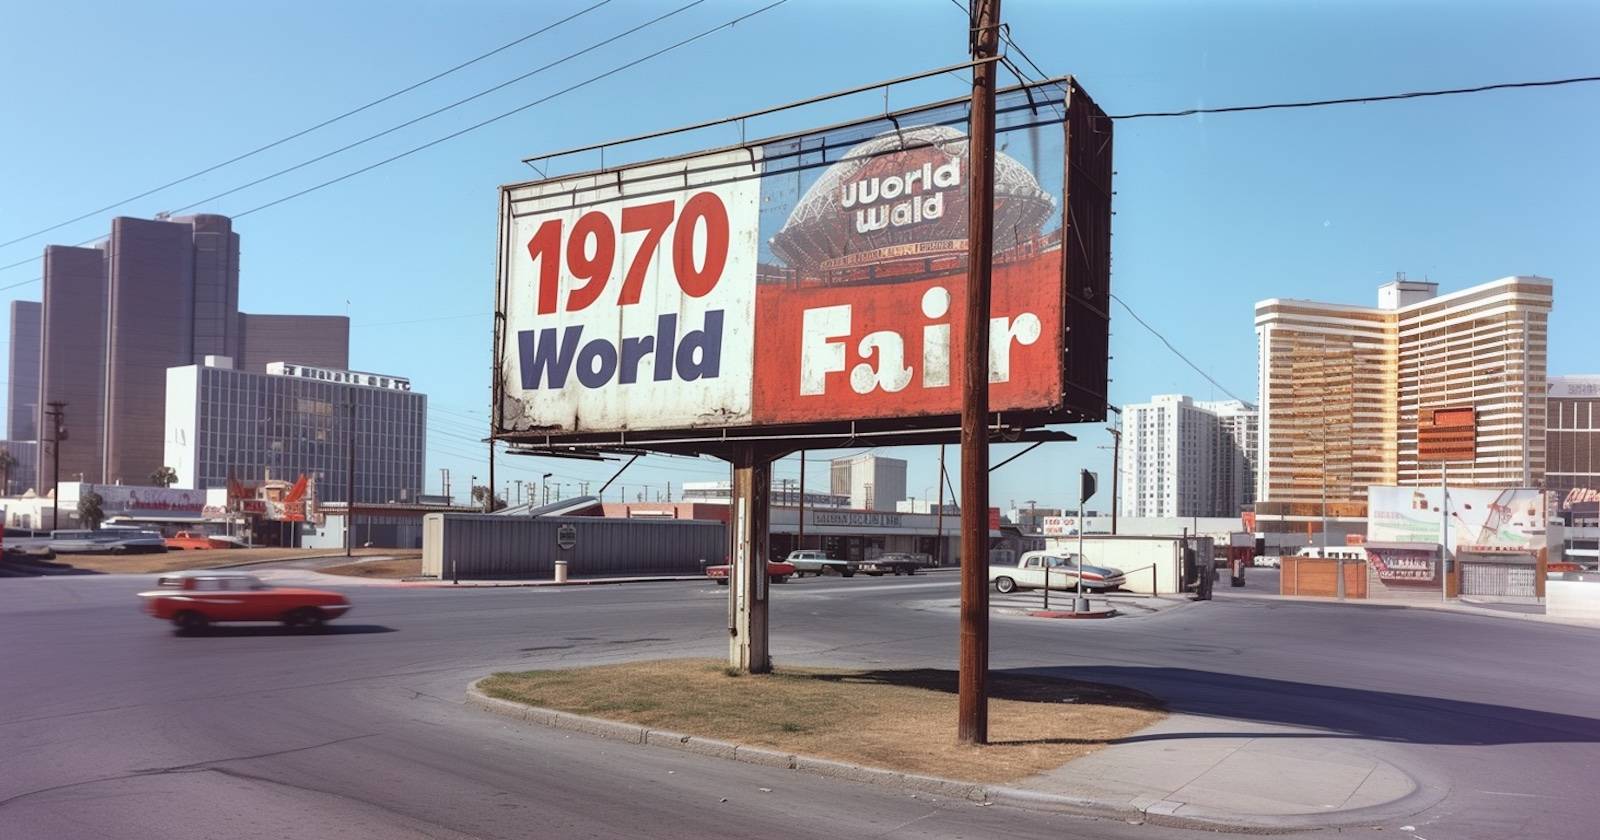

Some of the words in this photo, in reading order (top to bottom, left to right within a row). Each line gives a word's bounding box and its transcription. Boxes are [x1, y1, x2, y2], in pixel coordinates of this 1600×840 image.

[841, 157, 961, 212] World
[855, 191, 945, 234] Wald
[527, 191, 730, 315] 1970
[518, 309, 725, 390] World
[800, 286, 1042, 397] Fair
